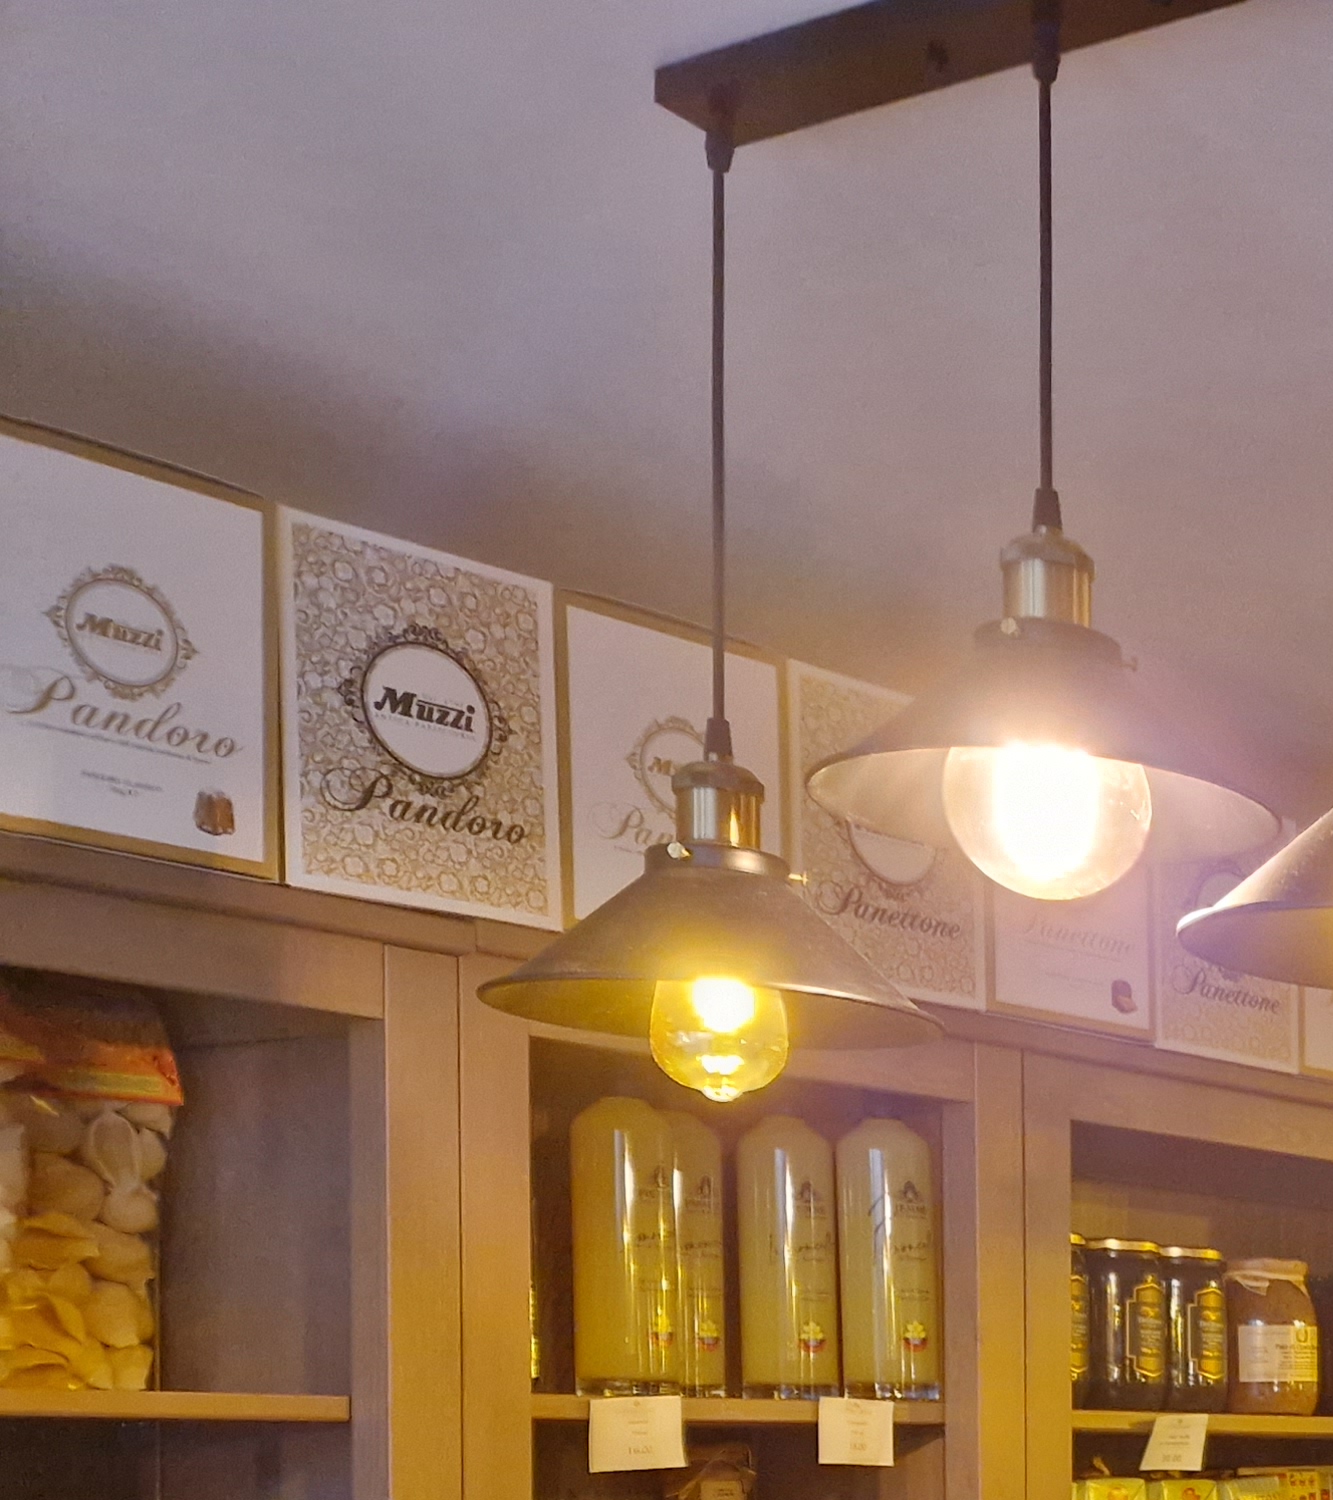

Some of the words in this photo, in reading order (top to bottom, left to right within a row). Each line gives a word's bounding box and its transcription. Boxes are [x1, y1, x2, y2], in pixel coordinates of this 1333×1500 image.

[75, 612, 165, 653] Muzzi
[4, 673, 241, 759] Pandoro
[373, 685, 476, 733] Muzzi
[320, 767, 528, 845] Pandoro
